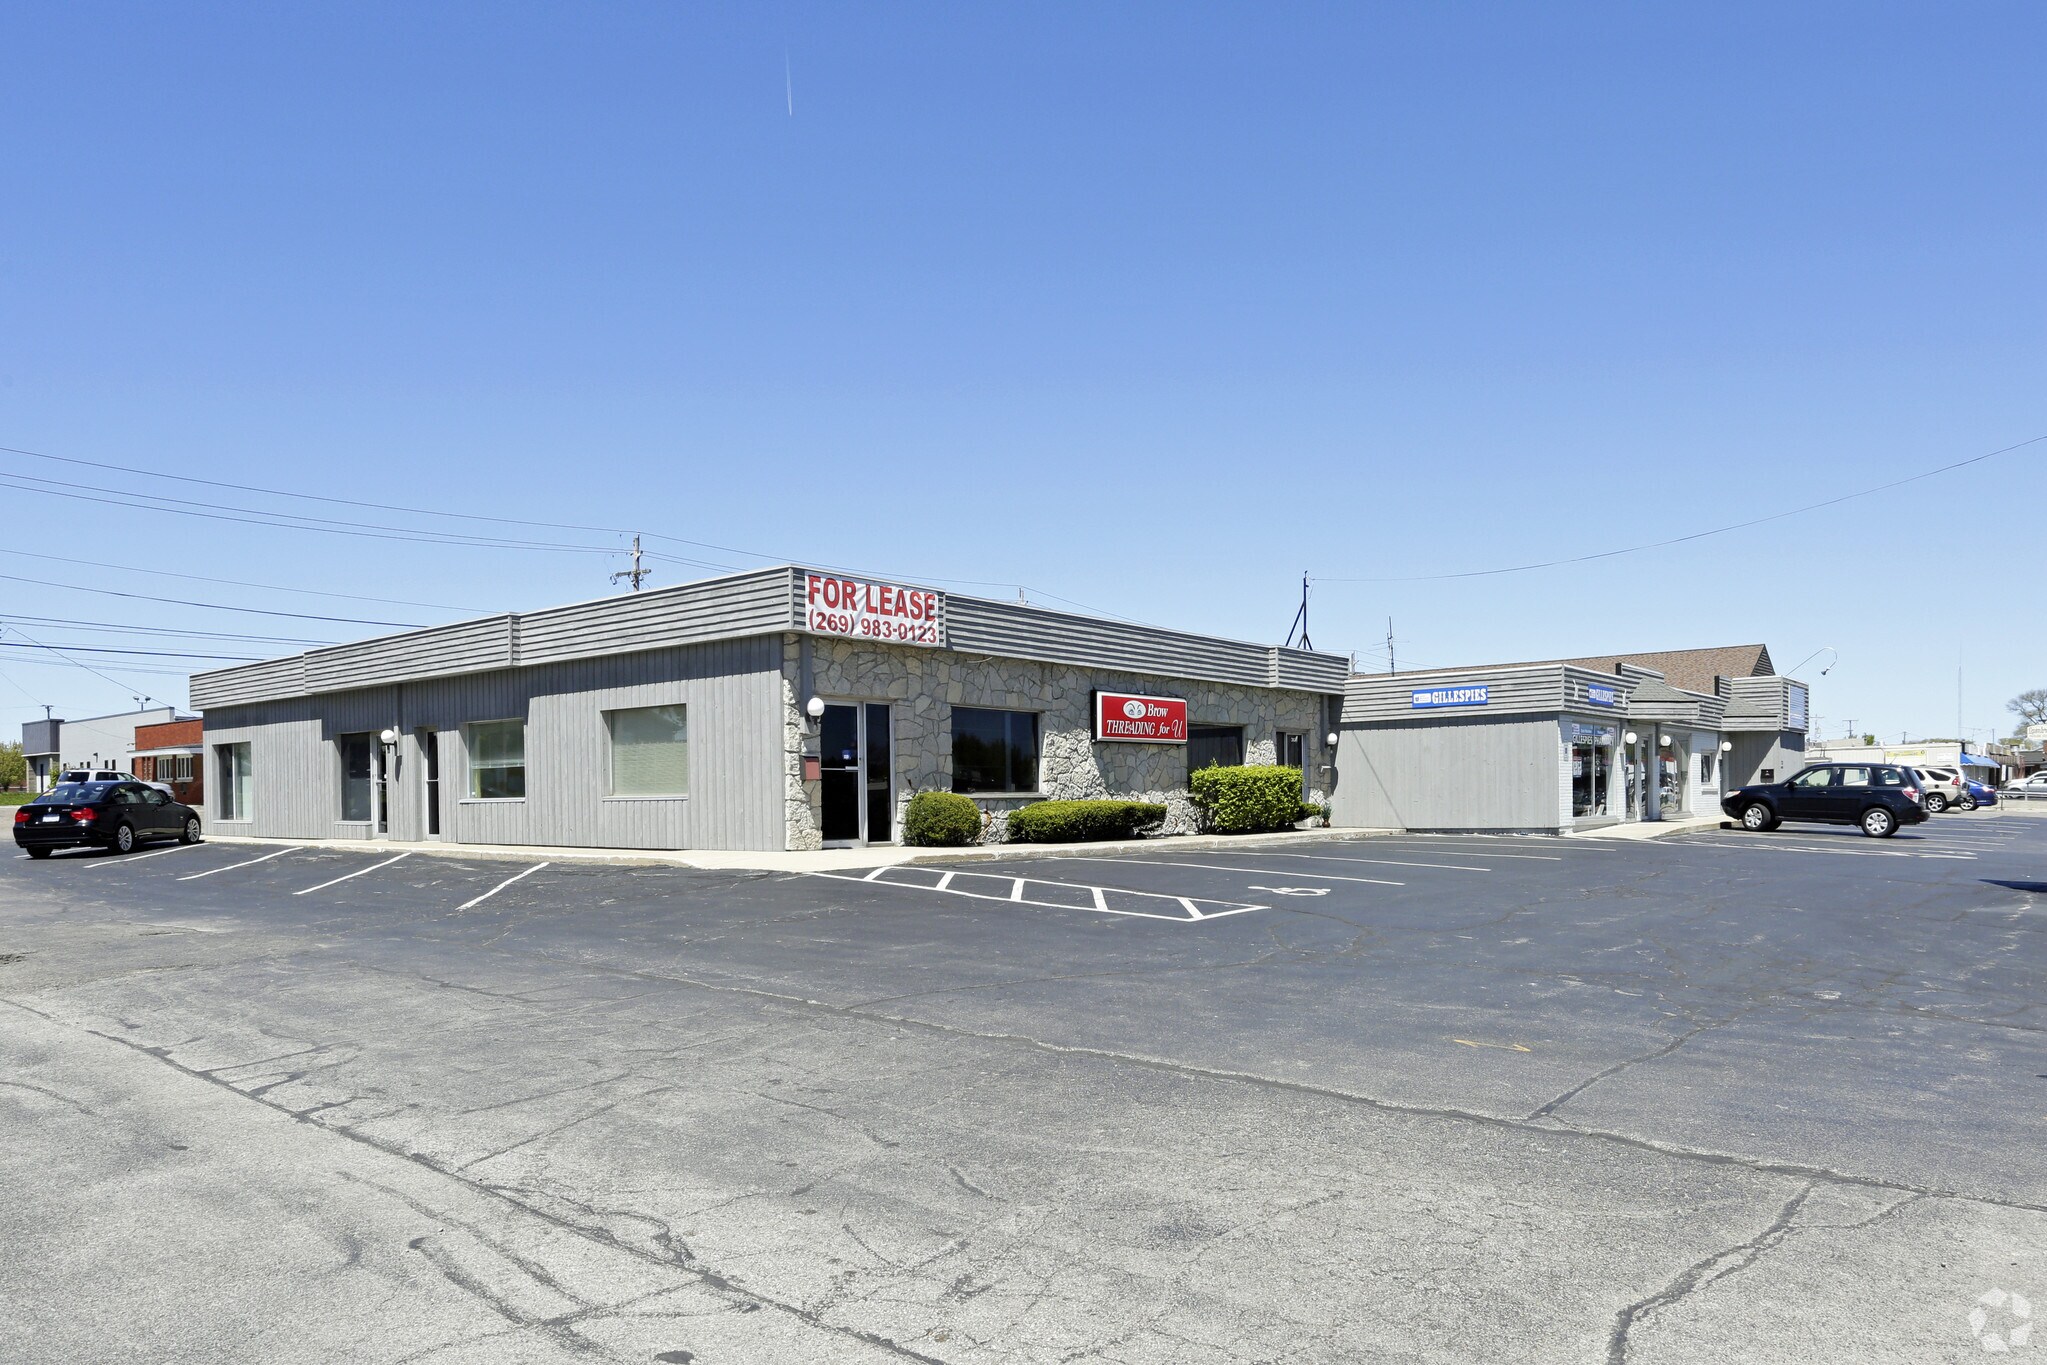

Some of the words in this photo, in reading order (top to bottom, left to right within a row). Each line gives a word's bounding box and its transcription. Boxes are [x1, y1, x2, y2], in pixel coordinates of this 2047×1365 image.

[808, 575, 858, 611] FOR
[866, 584, 936, 621] LEASE
[809, 609, 855, 636] (269)
[861, 618, 937, 644] 983-0123
[1432, 688, 1487, 704] GILLESPIES
[1147, 703, 1168, 717] Brow
[1106, 719, 1156, 736] THREADING
[1157, 722, 1170, 736] for
[1171, 719, 1183, 738] U
